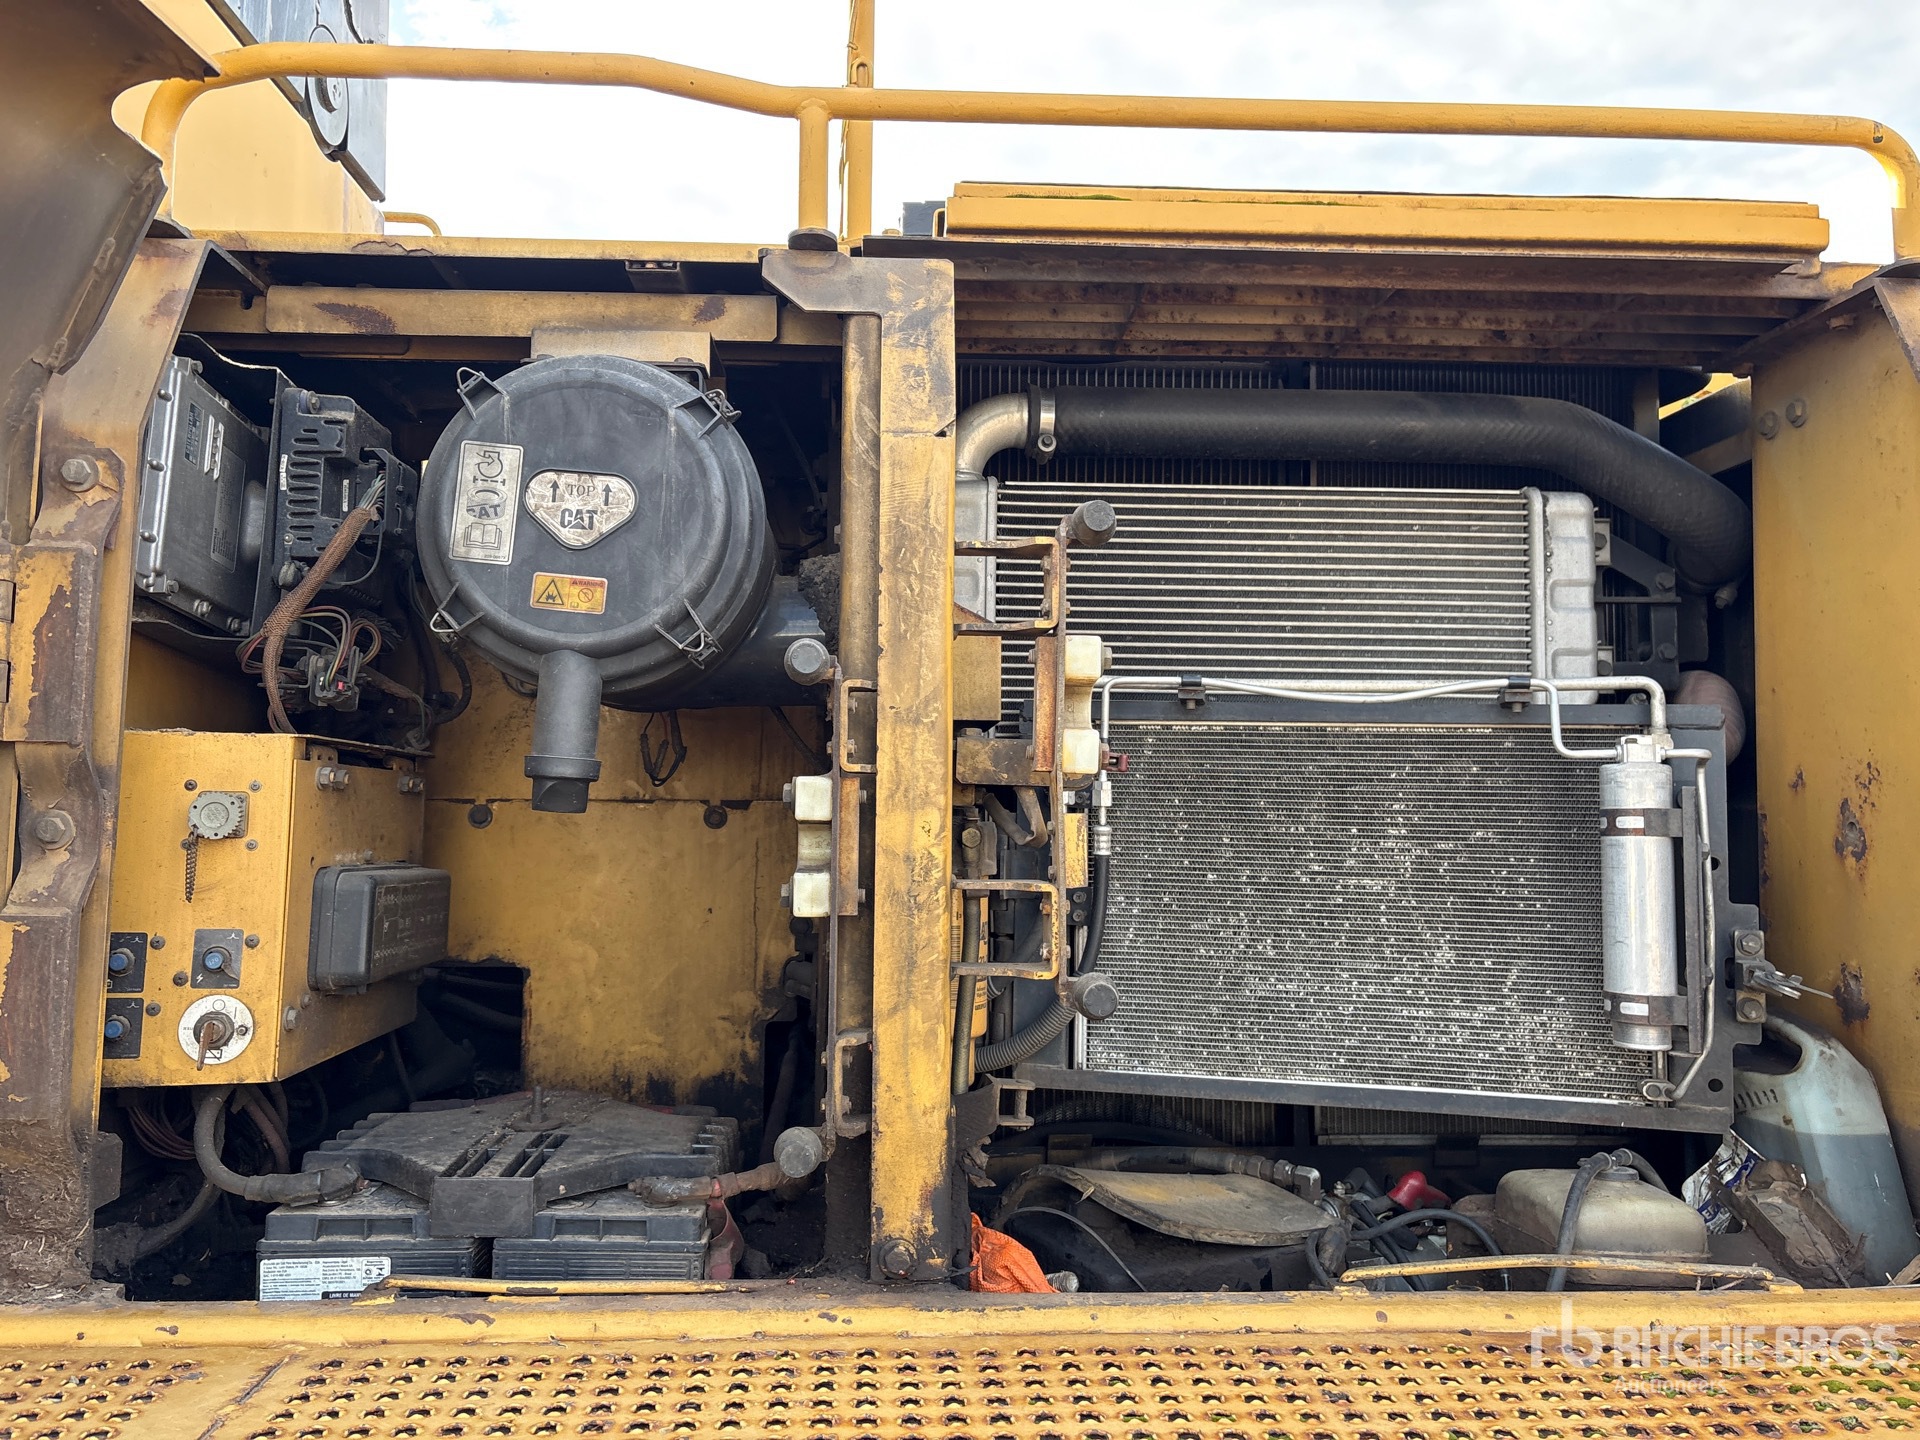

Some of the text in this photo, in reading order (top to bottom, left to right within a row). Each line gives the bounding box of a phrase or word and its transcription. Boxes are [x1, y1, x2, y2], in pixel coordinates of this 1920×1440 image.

[567, 484, 596, 496] TOP
[560, 508, 598, 530] CAT
[578, 580, 604, 588] WARNING
